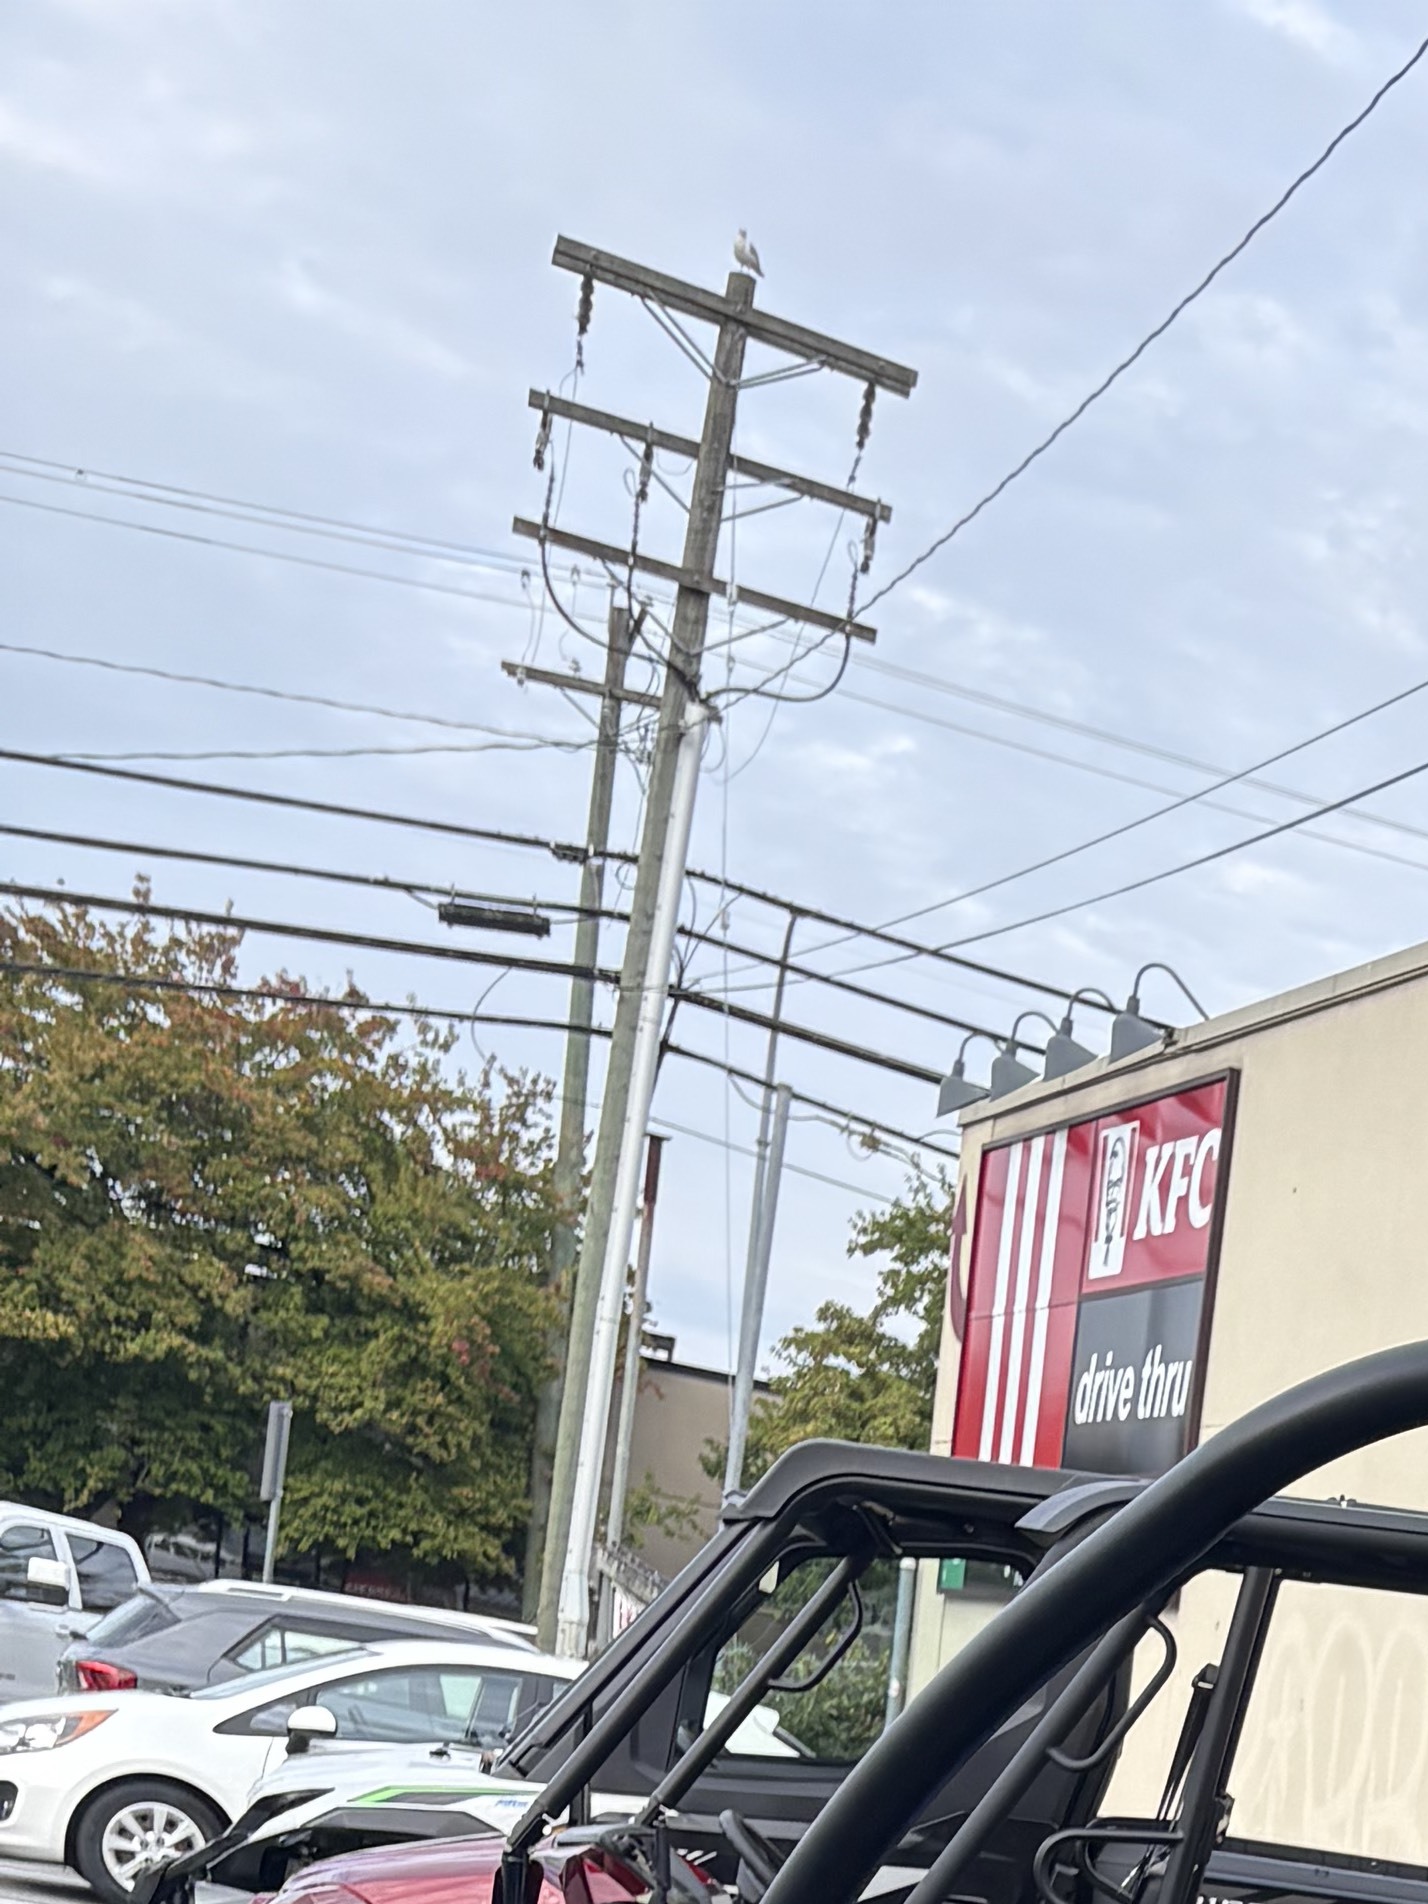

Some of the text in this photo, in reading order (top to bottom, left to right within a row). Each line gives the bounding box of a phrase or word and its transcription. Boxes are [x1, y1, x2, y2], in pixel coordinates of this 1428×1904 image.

[1133, 1128, 1221, 1240] KFC
[1075, 1344, 1192, 1425] drive thru
